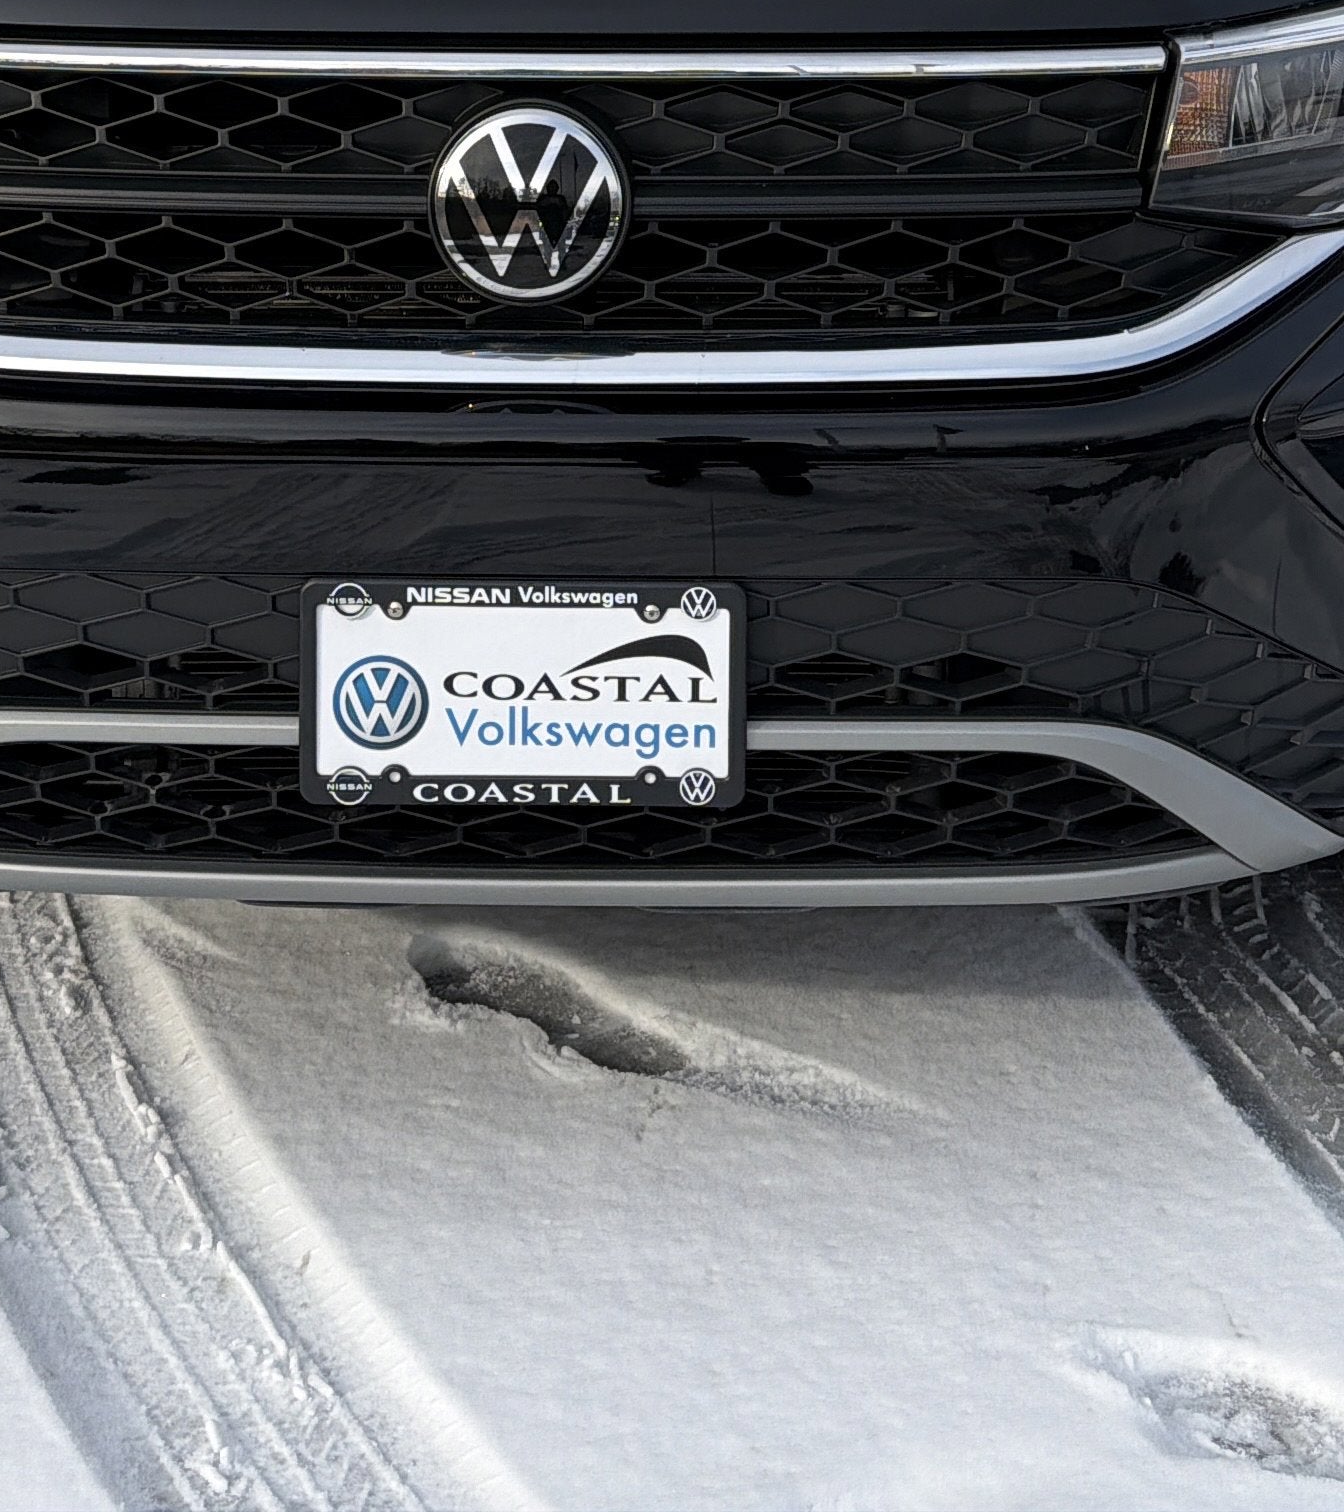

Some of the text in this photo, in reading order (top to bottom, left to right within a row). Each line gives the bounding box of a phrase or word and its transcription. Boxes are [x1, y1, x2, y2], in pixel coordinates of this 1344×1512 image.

[326, 597, 373, 605] NISSAN
[406, 586, 638, 607] NISSAN Volkswagen
[443, 671, 718, 704] COASTAL
[444, 705, 716, 760] Volkswagen
[326, 783, 373, 791] NISSAN
[412, 782, 632, 804] COASTAL
